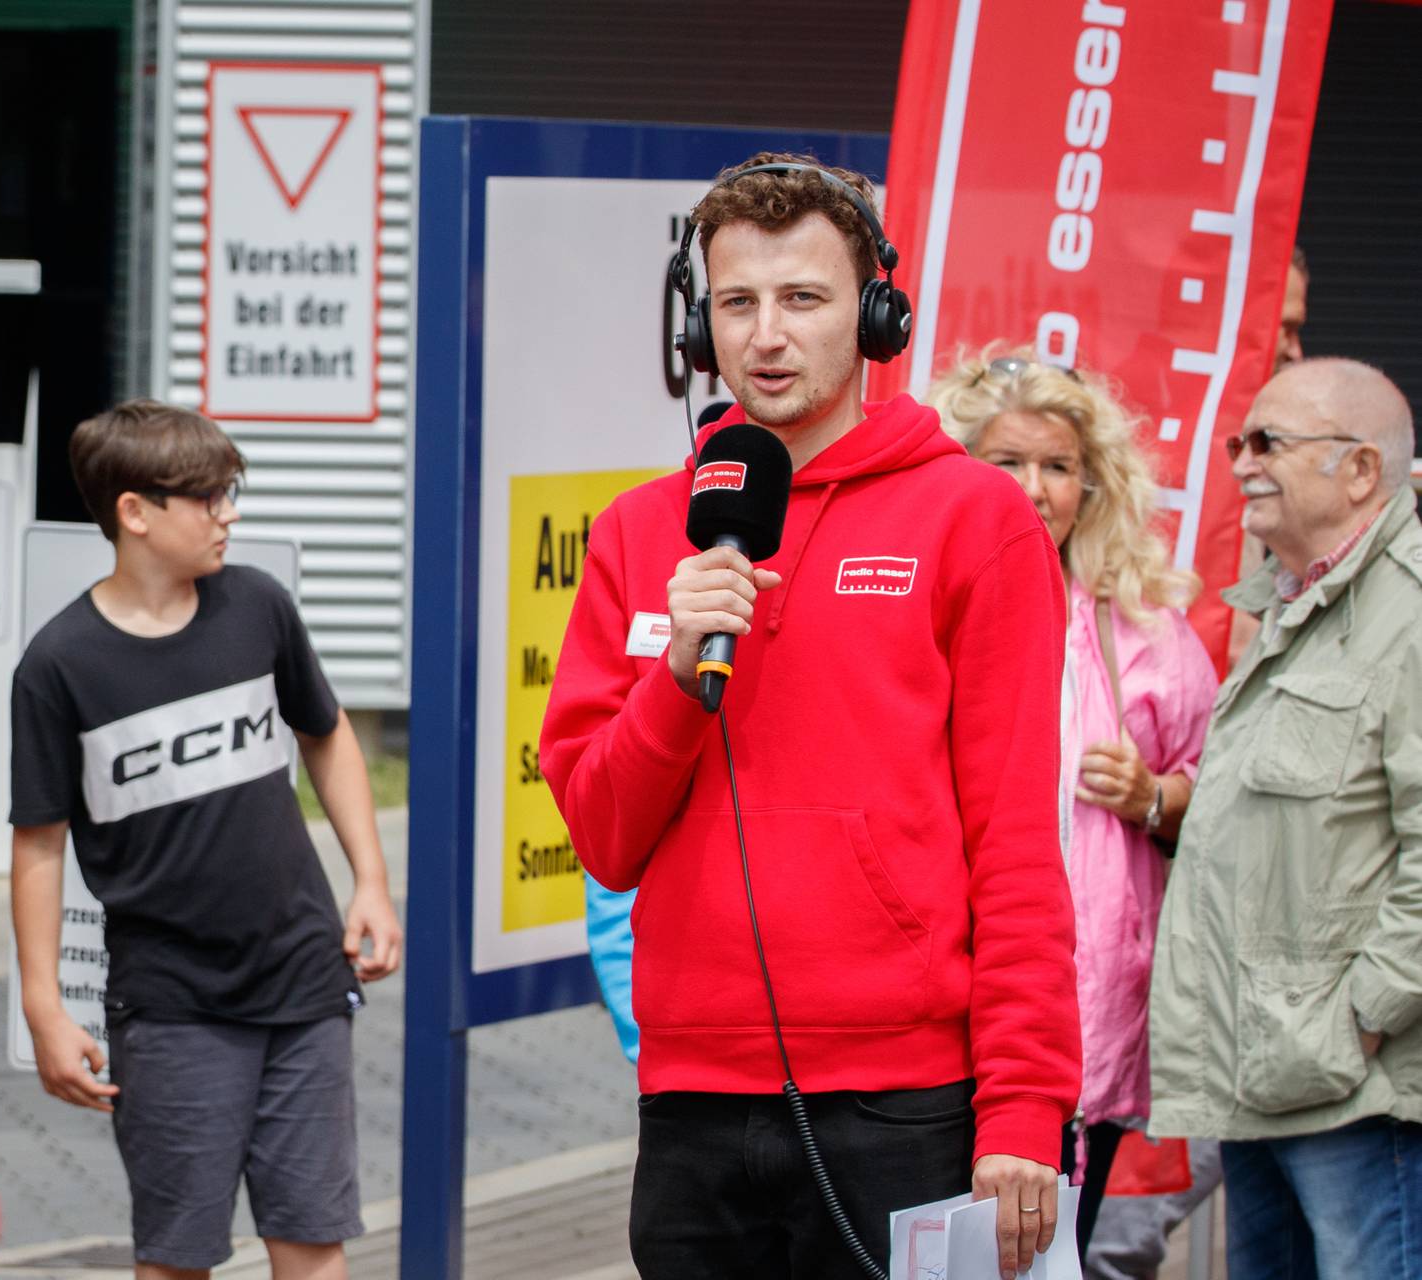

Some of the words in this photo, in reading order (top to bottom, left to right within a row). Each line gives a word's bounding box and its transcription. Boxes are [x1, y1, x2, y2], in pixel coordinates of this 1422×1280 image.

[227, 241, 357, 275] Vorsicht
[236, 292, 282, 325] bei
[296, 293, 345, 325] der
[228, 344, 354, 379] Einfahrt
[843, 567, 874, 577] radio
[876, 568, 911, 578] essen
[113, 706, 274, 786] CCM
